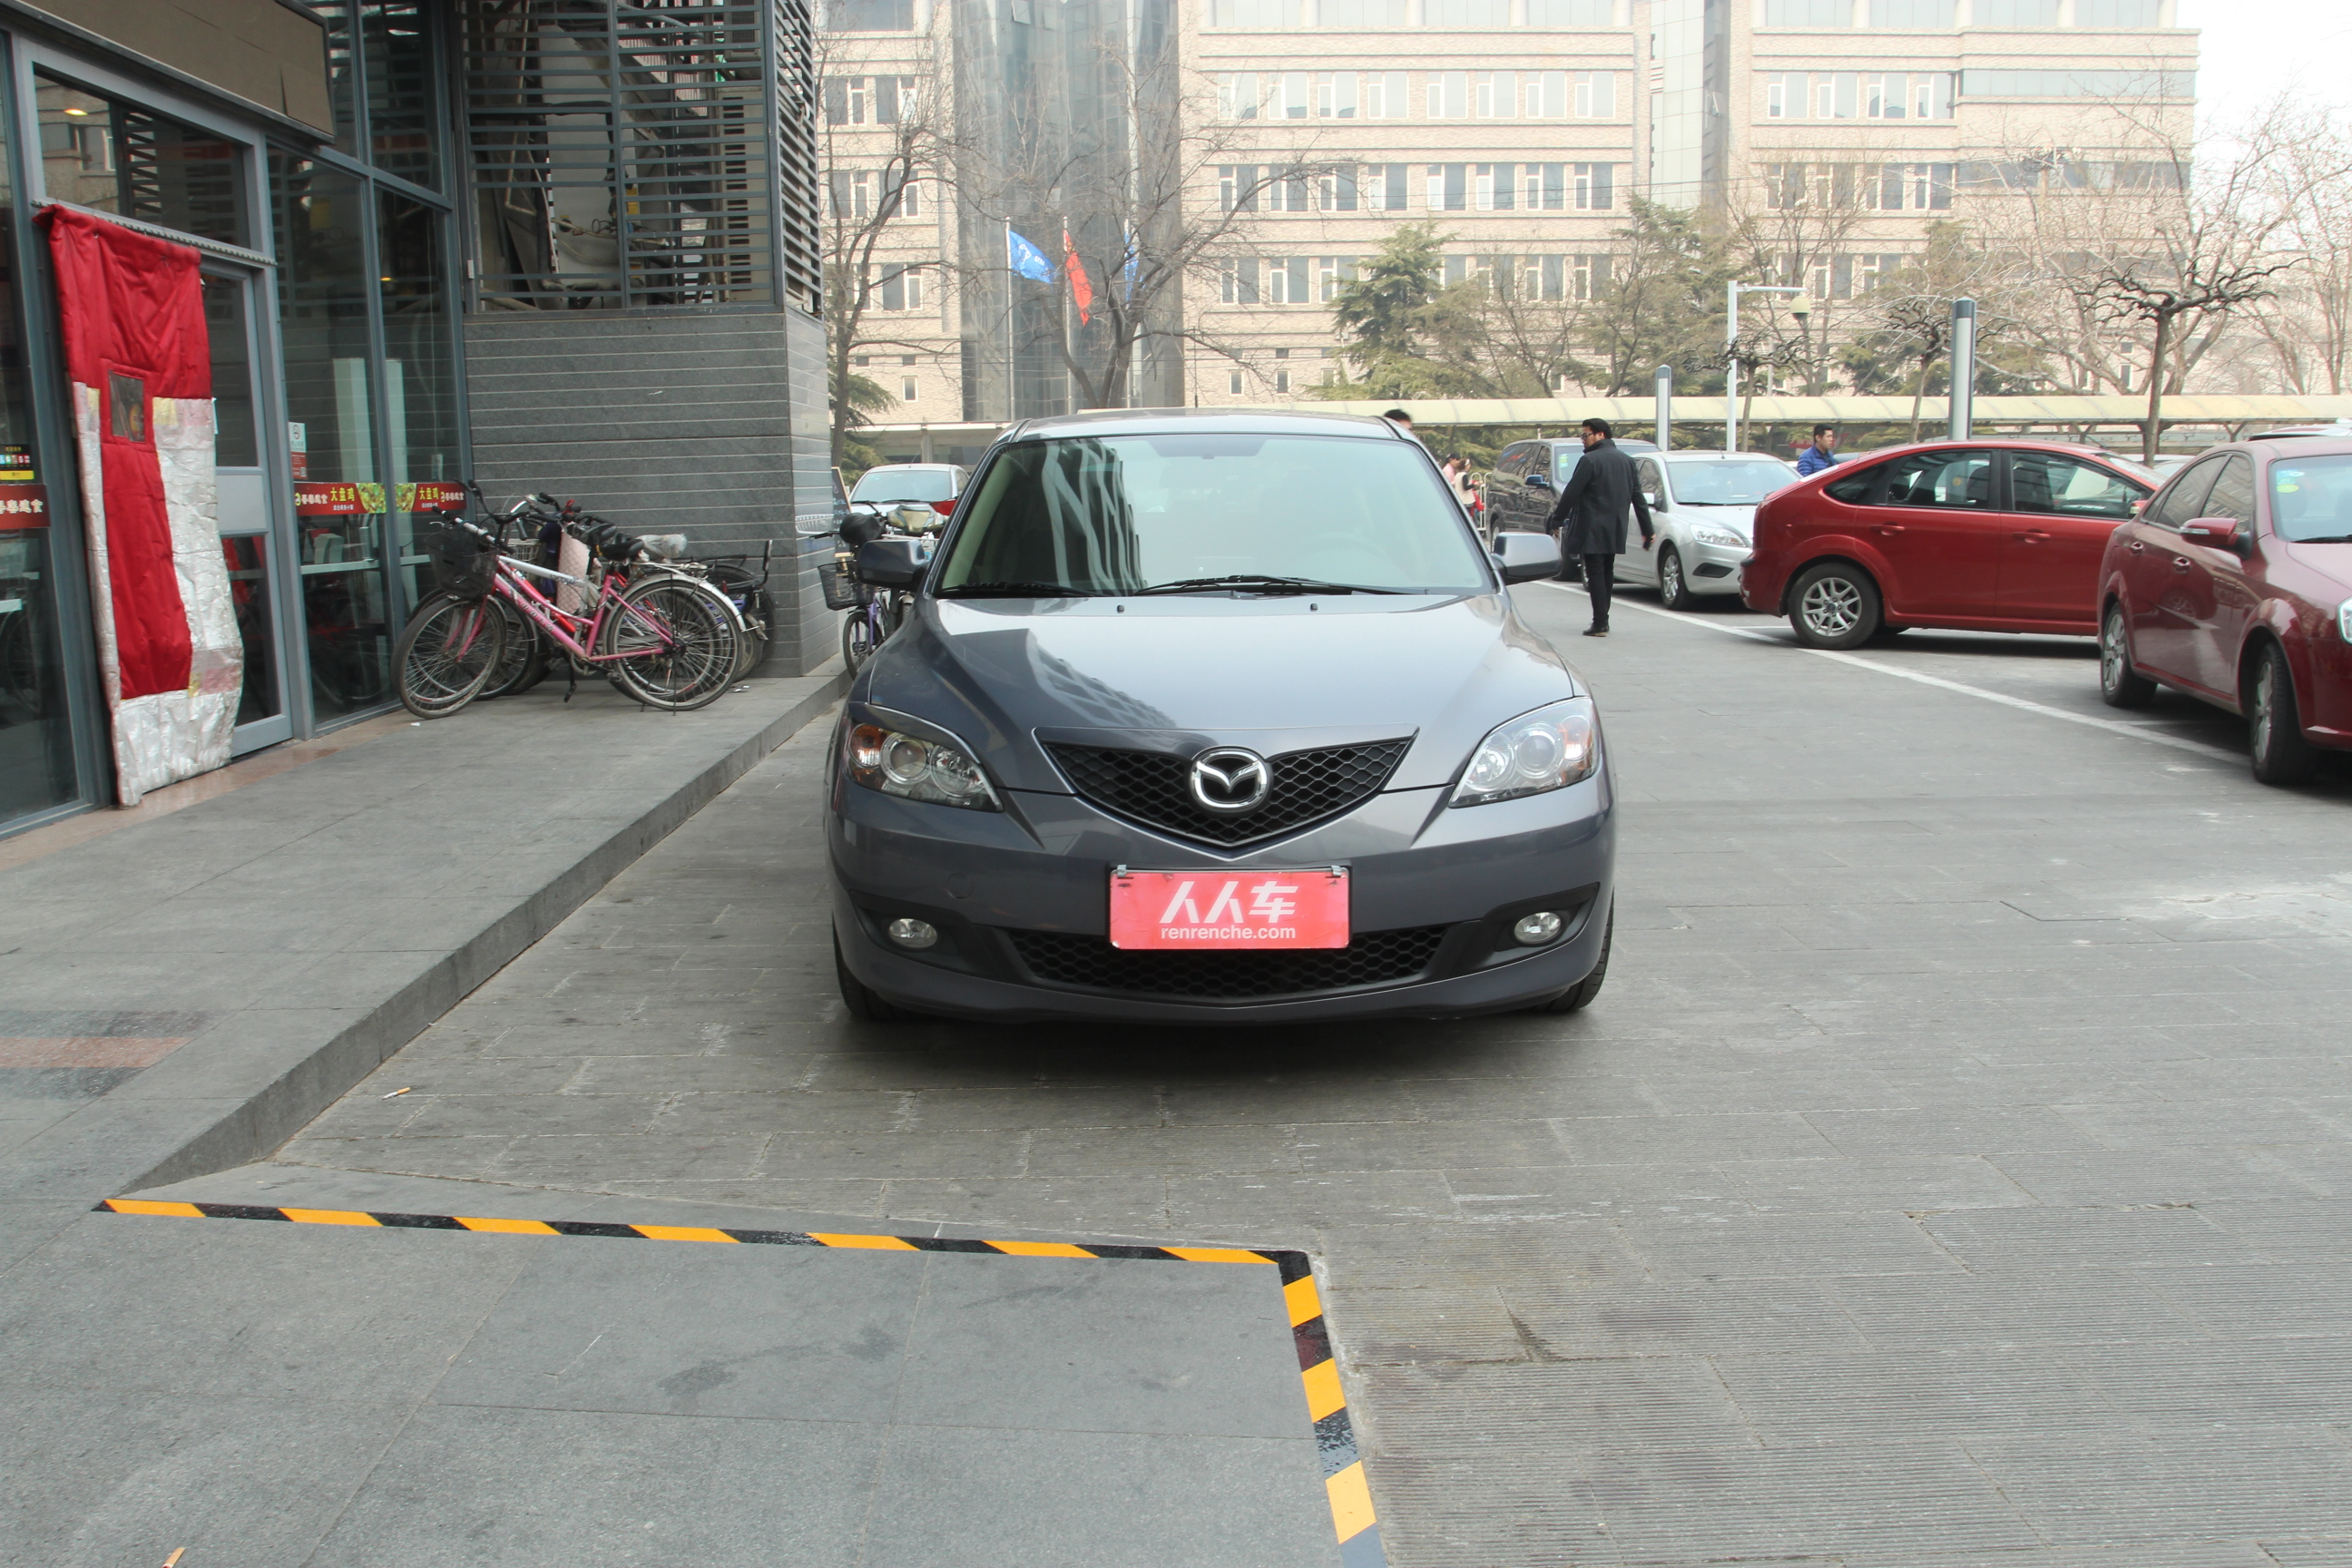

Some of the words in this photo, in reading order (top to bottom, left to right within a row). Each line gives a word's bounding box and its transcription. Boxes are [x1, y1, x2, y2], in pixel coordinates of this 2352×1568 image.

[329, 486, 355, 502] 大盘鸡
[418, 486, 439, 500] 大盘鸡
[1159, 880, 1299, 924] 人人车
[1161, 925, 1297, 940] renrenche.com
